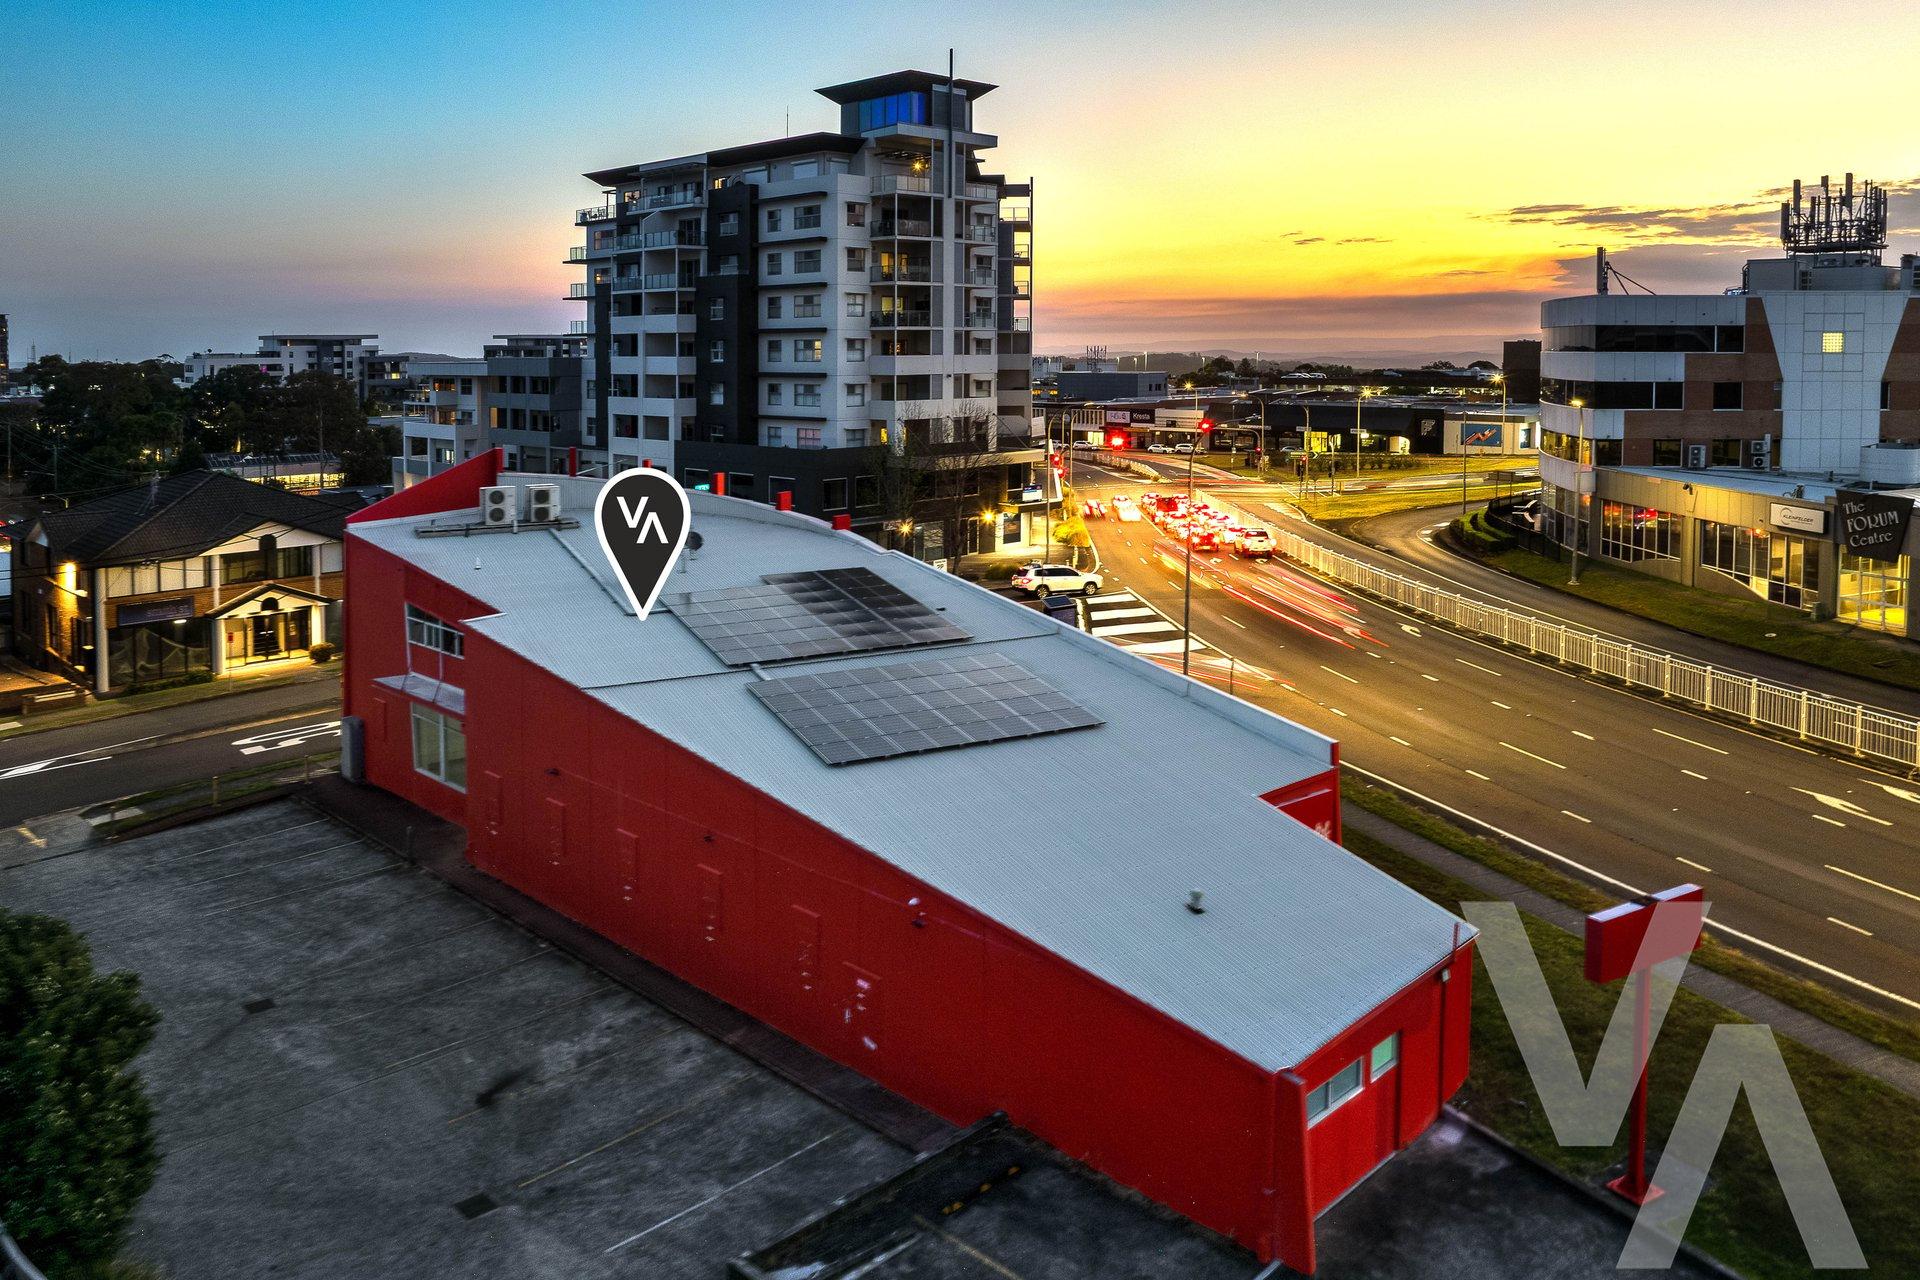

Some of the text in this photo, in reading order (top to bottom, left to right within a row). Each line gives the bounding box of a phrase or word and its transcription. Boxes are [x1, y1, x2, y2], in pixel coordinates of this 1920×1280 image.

[1132, 412, 1151, 420] Kresta
[1843, 501, 1865, 514] The
[1783, 514, 1814, 523] KLEINFELDER
[1847, 510, 1899, 533] FORUM
[1850, 532, 1893, 547] Centre
